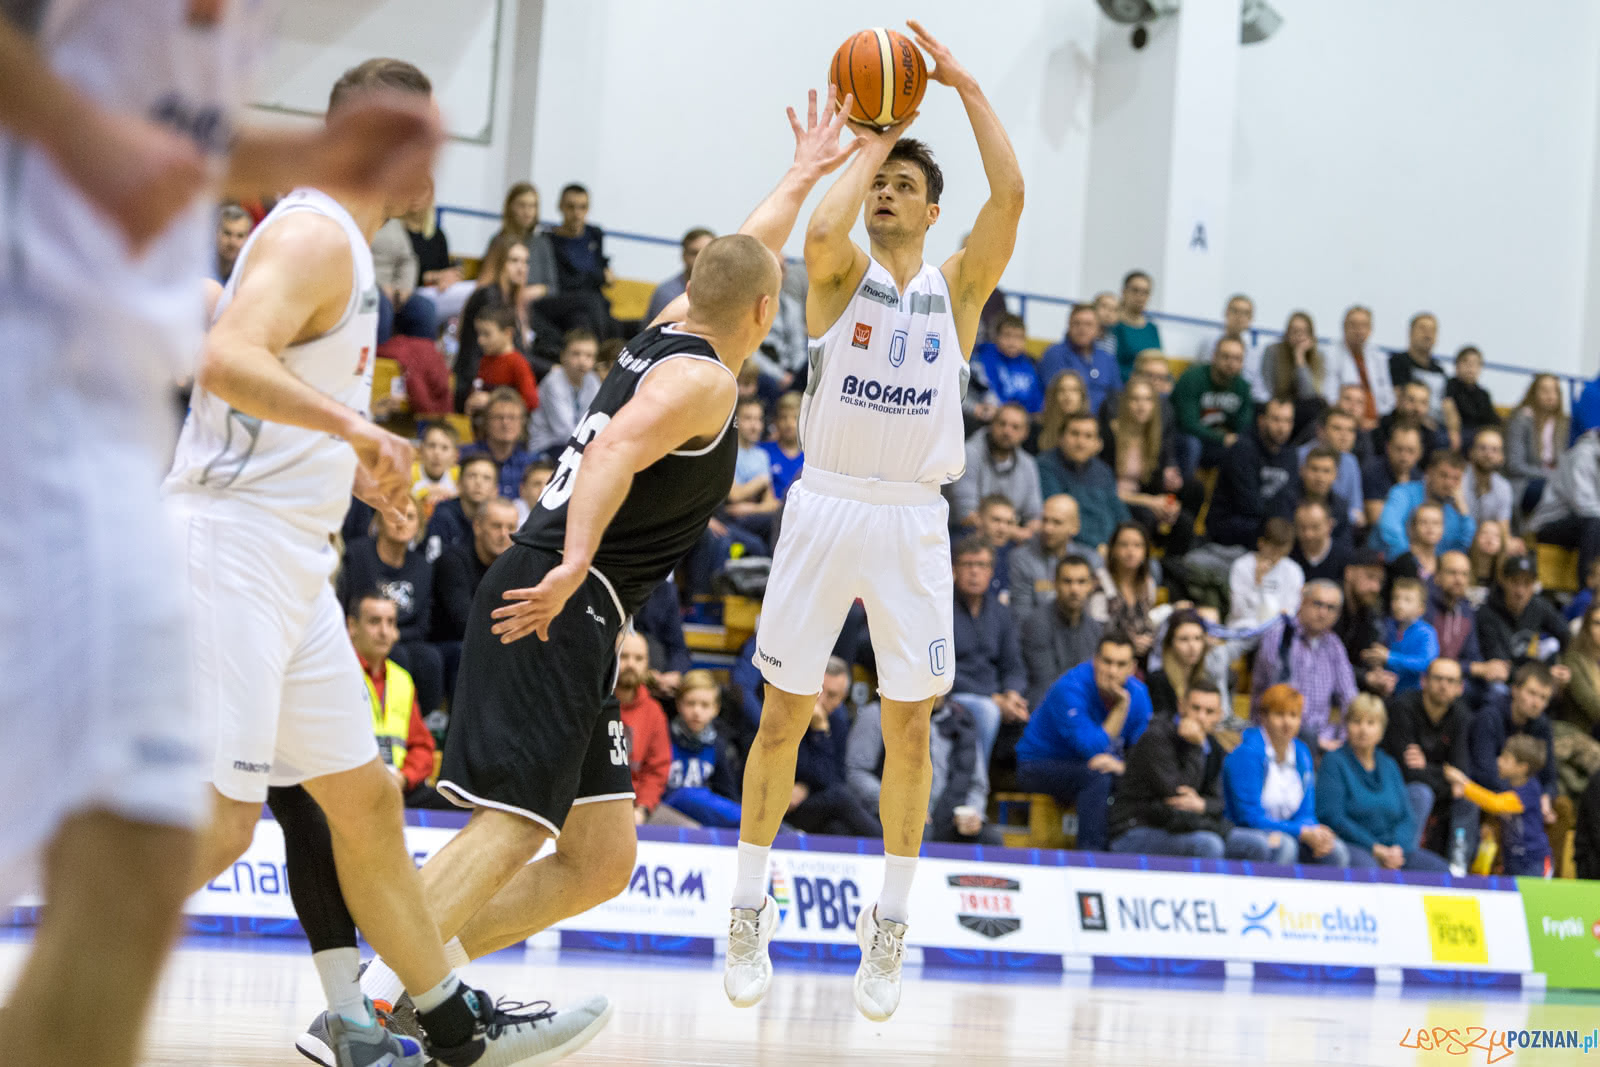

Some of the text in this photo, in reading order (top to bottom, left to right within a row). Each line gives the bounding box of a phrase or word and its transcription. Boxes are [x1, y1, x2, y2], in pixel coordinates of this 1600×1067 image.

[1189, 222, 1208, 250] A
[840, 395, 867, 408] POLSKI
[793, 876, 862, 931] PBG
[1117, 897, 1228, 934] NICKEL
